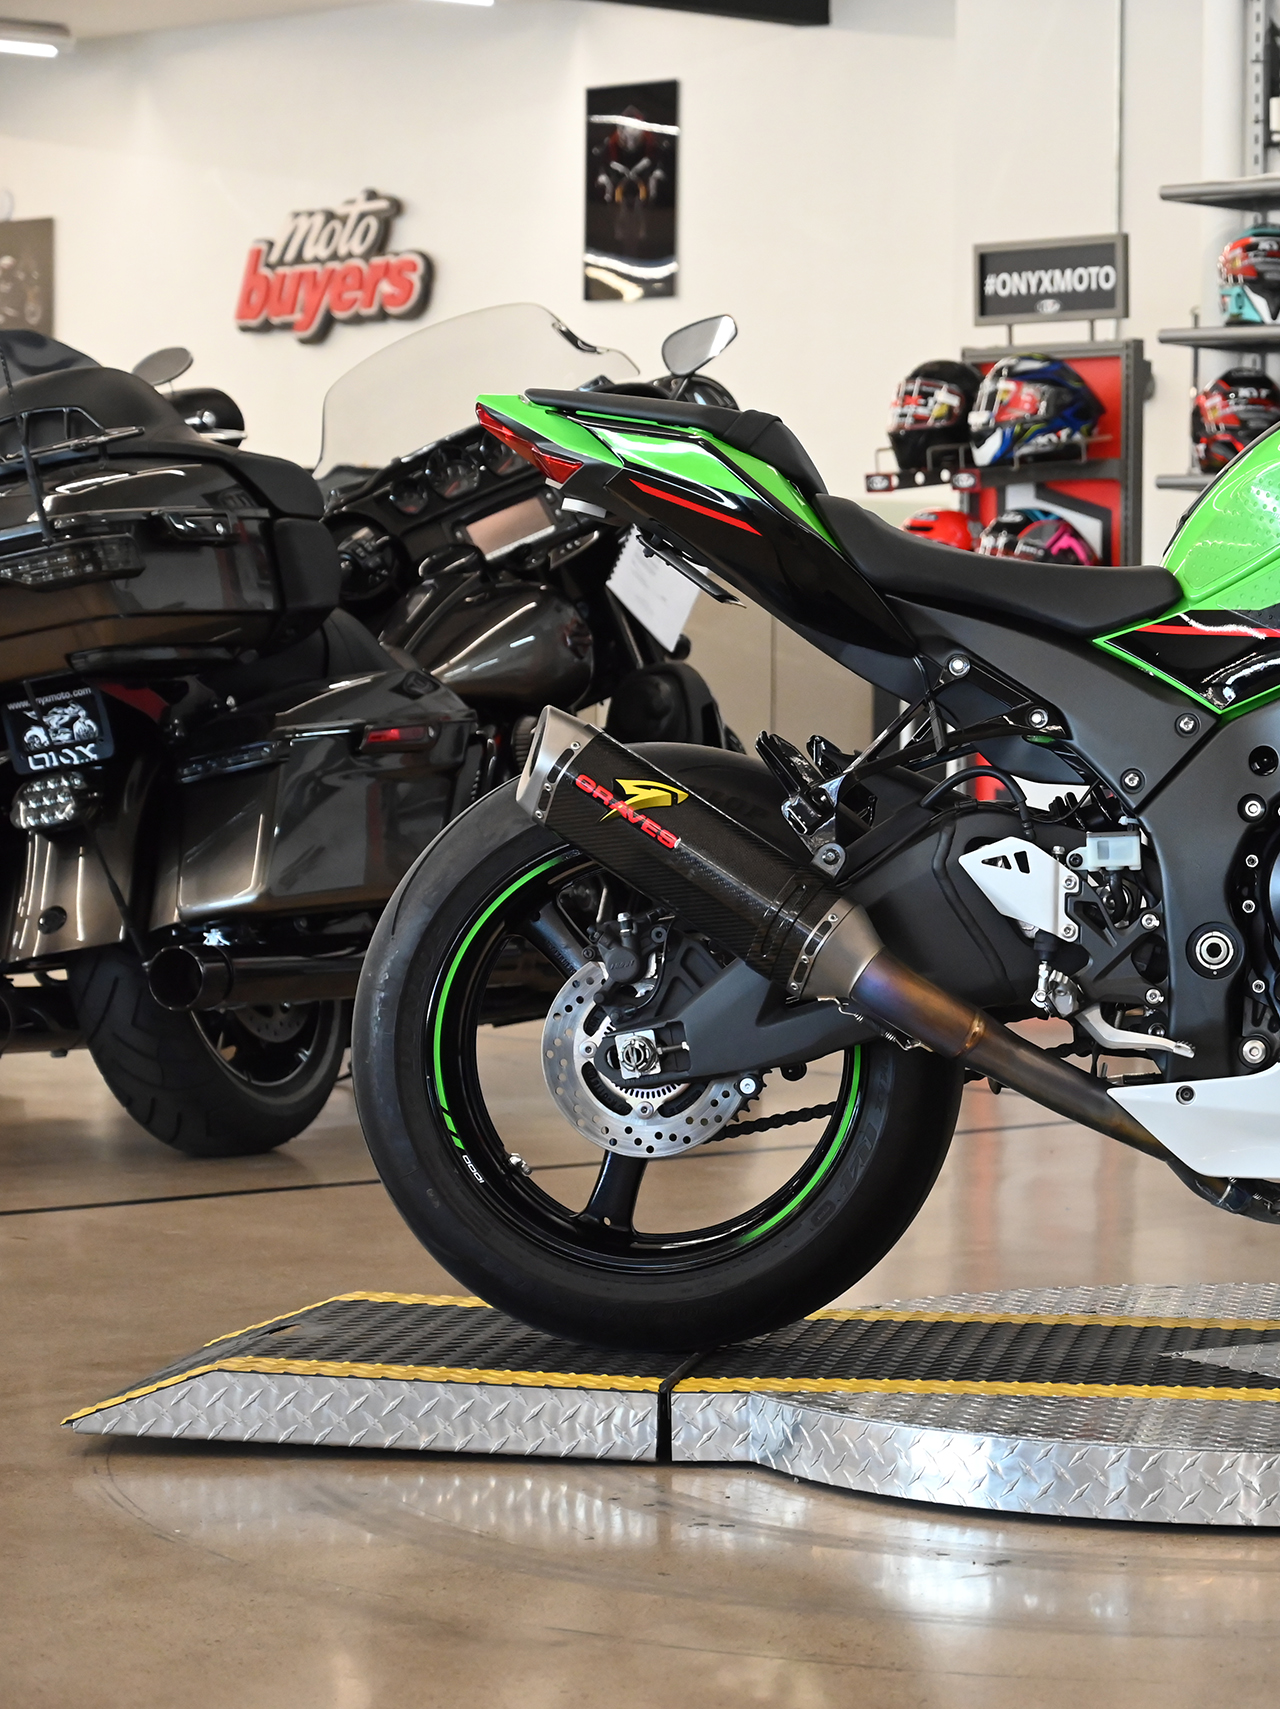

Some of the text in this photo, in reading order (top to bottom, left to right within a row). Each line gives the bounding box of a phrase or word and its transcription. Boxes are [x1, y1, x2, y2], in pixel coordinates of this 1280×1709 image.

[235, 245, 423, 334] buyers
[983, 264, 1117, 297] #ONYXMOTO
[6, 687, 93, 711] www.nyxmoto.com
[575, 773, 678, 849] GRAVES
